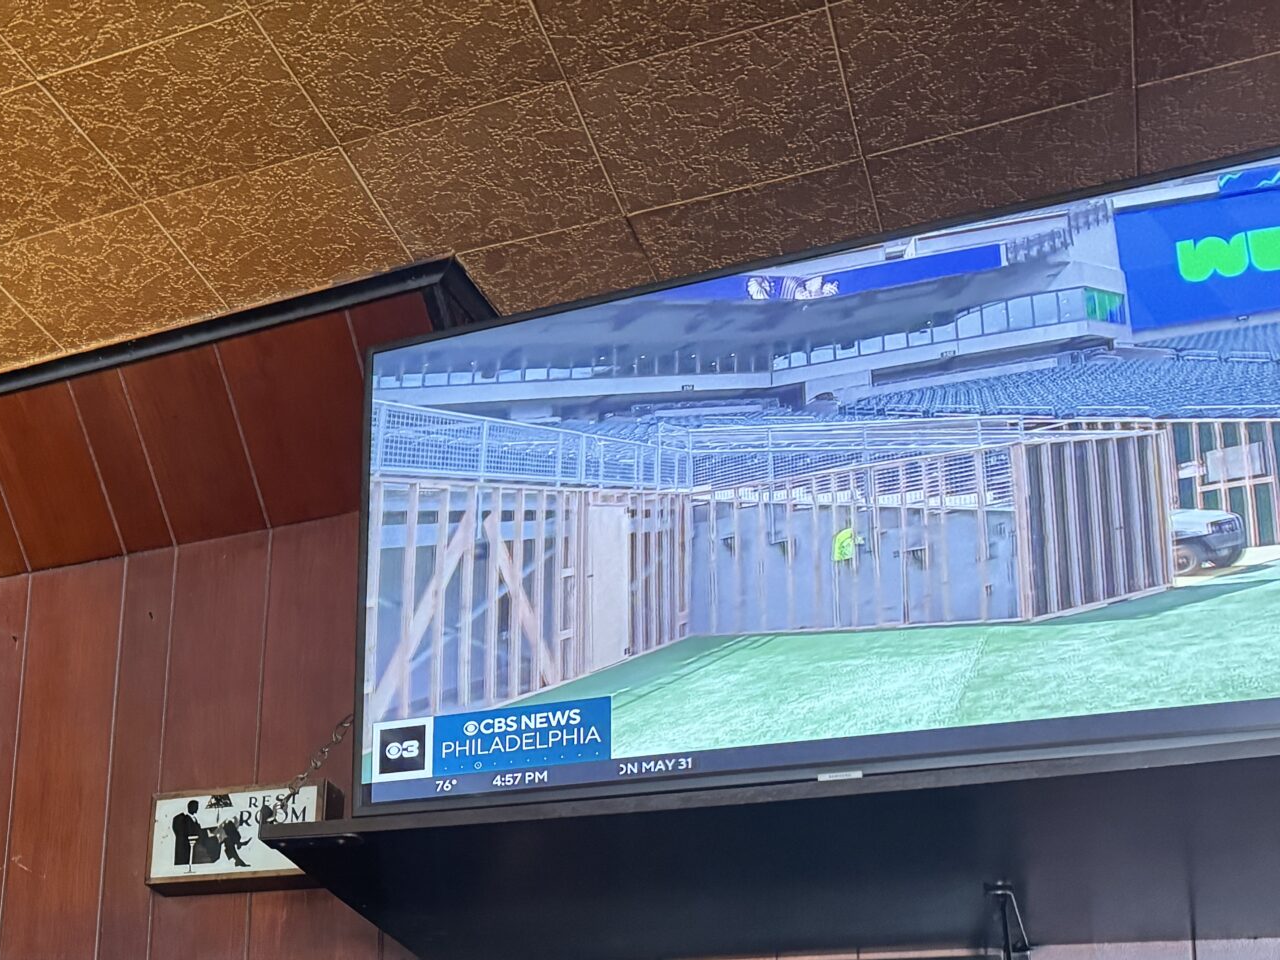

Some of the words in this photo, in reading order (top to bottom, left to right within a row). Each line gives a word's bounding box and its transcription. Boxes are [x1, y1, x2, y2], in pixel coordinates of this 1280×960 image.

[479, 716, 518, 734] CBS
[521, 708, 581, 729] NEWS
[442, 726, 602, 759] PHILADELPHIA
[642, 758, 676, 773] MAY
[678, 757, 693, 770] 31
[435, 778, 458, 792] 76°
[492, 772, 522, 787] 4:57
[525, 770, 548, 784] PM
